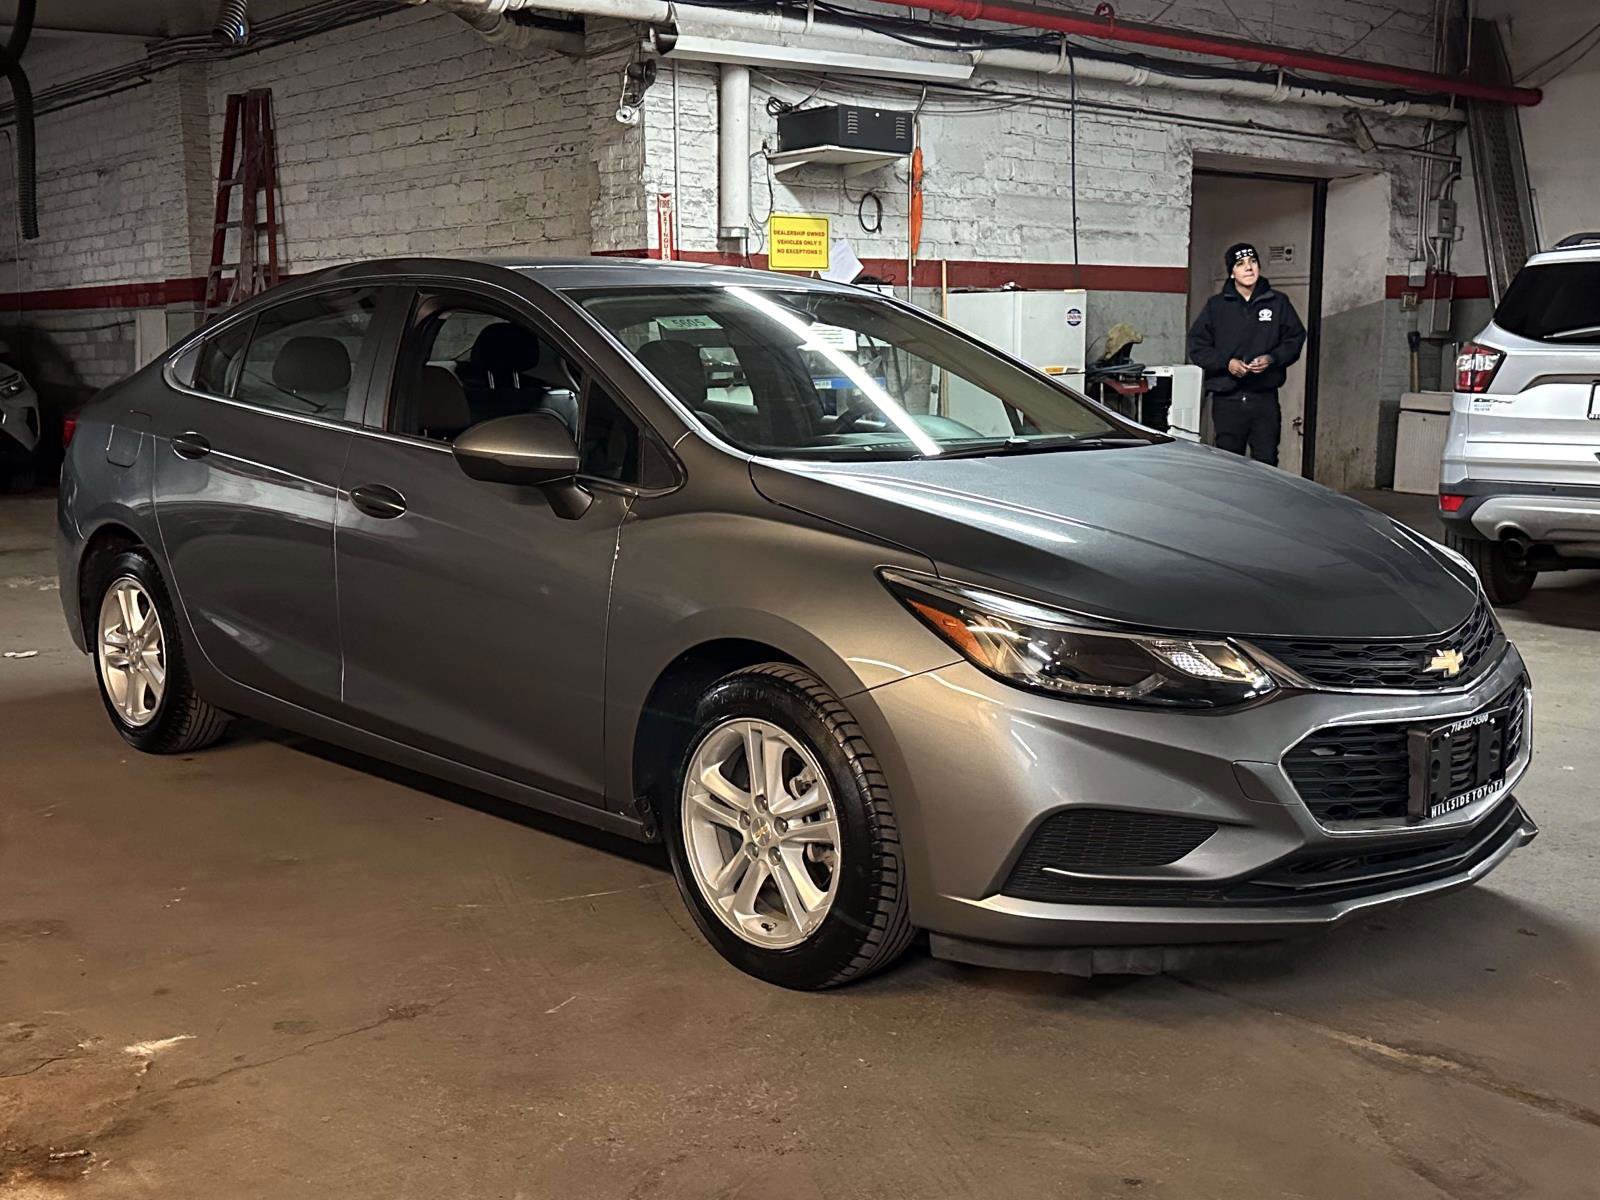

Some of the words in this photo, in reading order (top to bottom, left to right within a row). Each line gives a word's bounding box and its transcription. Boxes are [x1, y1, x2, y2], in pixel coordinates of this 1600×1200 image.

[659, 199, 670, 209] FIRE
[1431, 795, 1470, 818] HILLSIDE
[1472, 779, 1504, 801] TOYOTA
